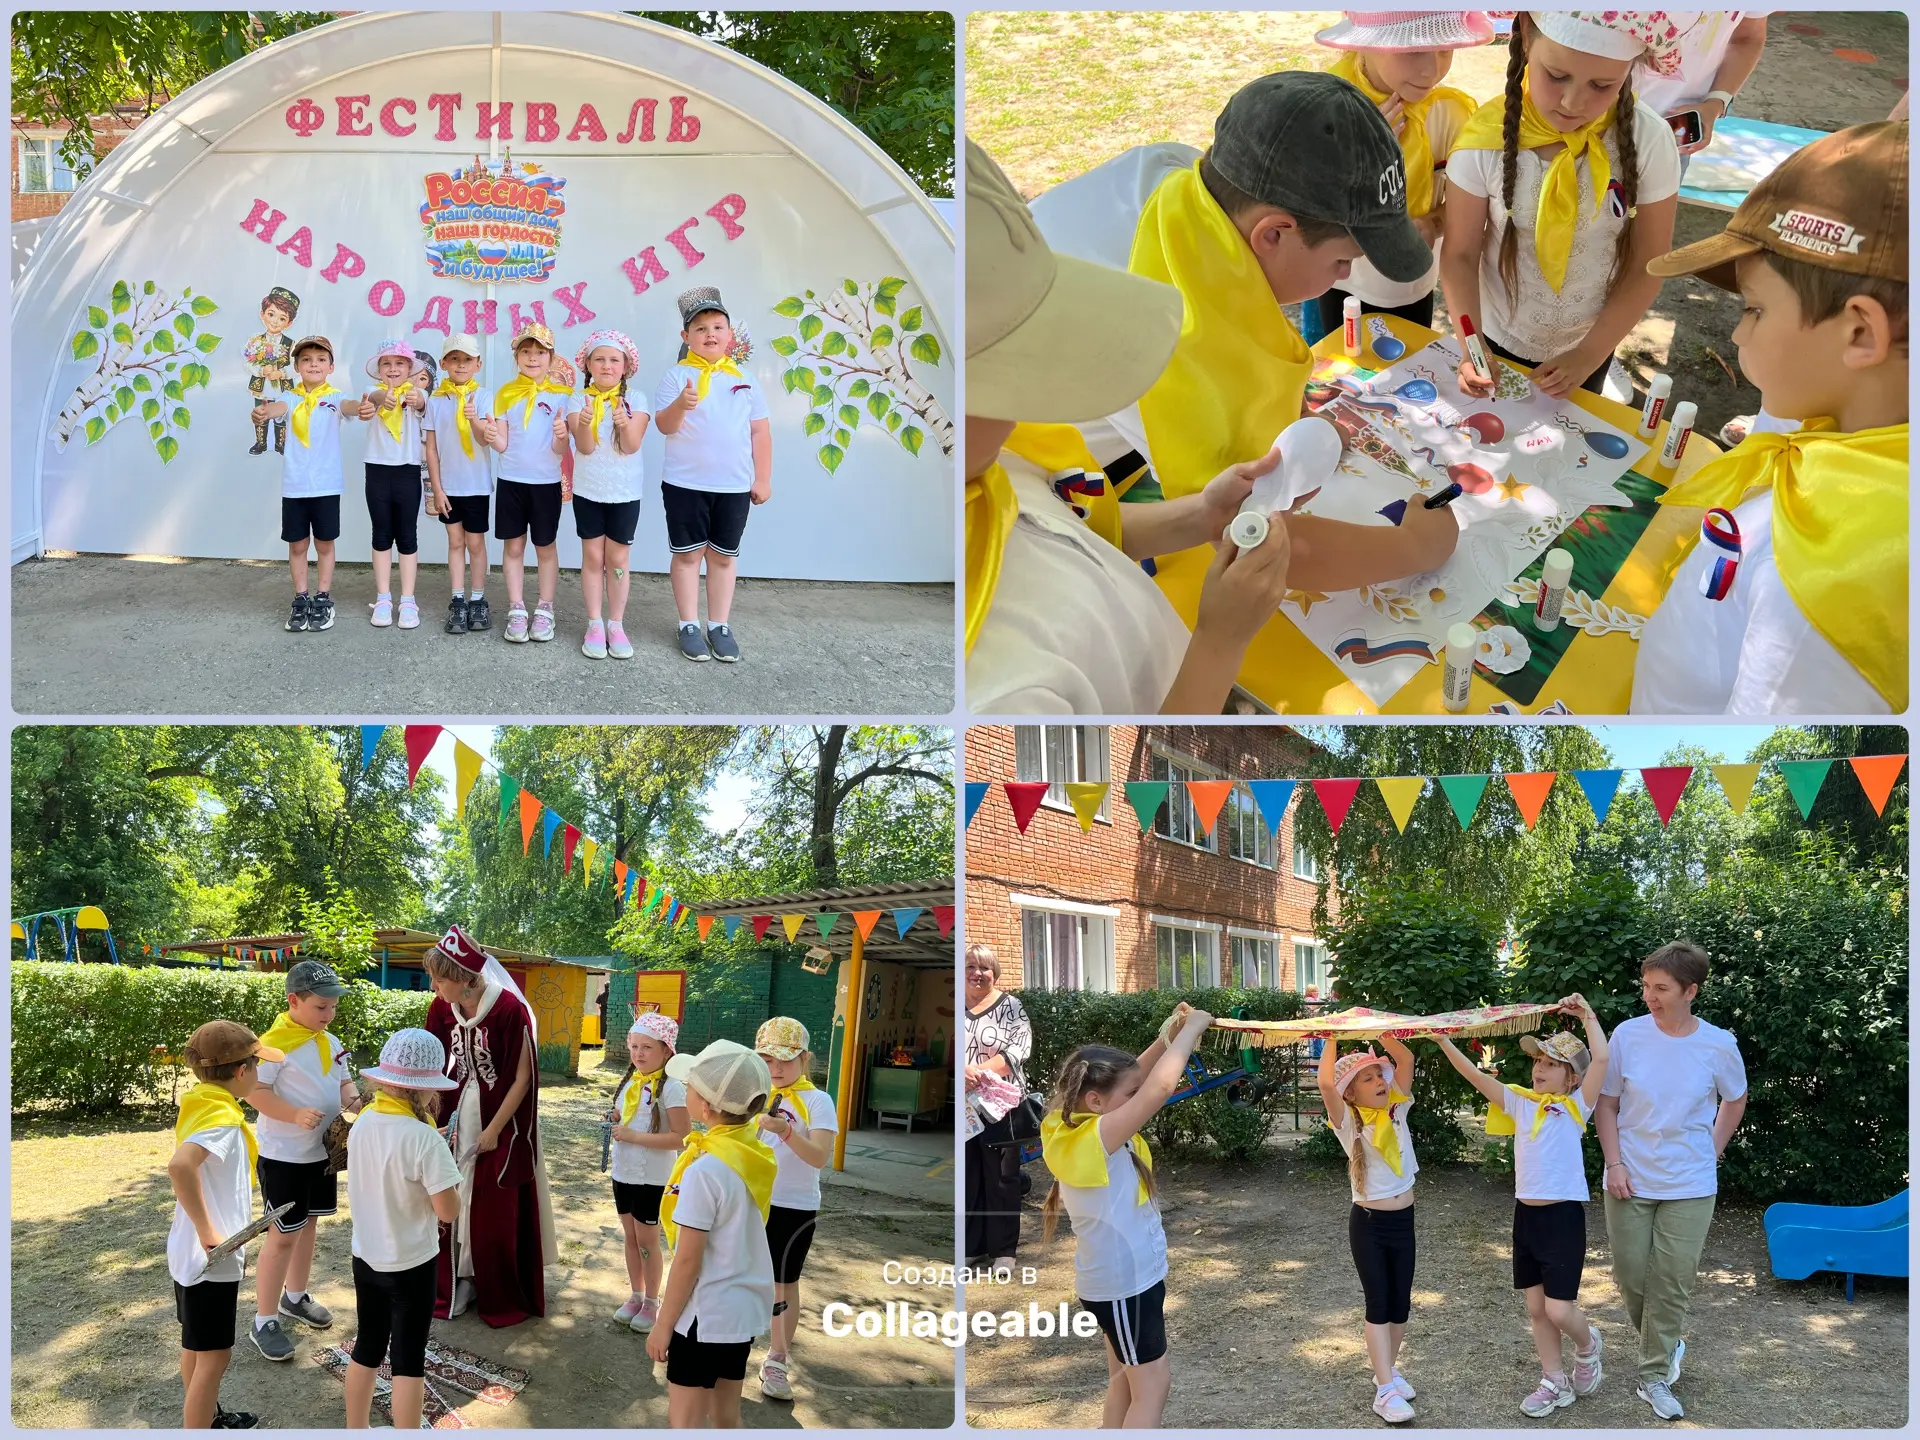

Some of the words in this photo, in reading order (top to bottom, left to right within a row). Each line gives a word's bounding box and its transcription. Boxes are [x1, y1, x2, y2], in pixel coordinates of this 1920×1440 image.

[285, 93, 701, 143] ФЕСТИВАЛЬ
[1378, 159, 1405, 205] COL
[436, 208, 469, 223] наш
[472, 206, 526, 223] общий
[528, 215, 562, 232] дом,
[1786, 213, 1845, 242] SPORTS
[435, 225, 479, 241] наша
[482, 225, 555, 246] гордость
[1779, 230, 1838, 256] ELEMENTS
[239, 198, 597, 338] НАРОДНЫХ
[621, 193, 747, 295] ИГР
[460, 260, 544, 282] будущее!
